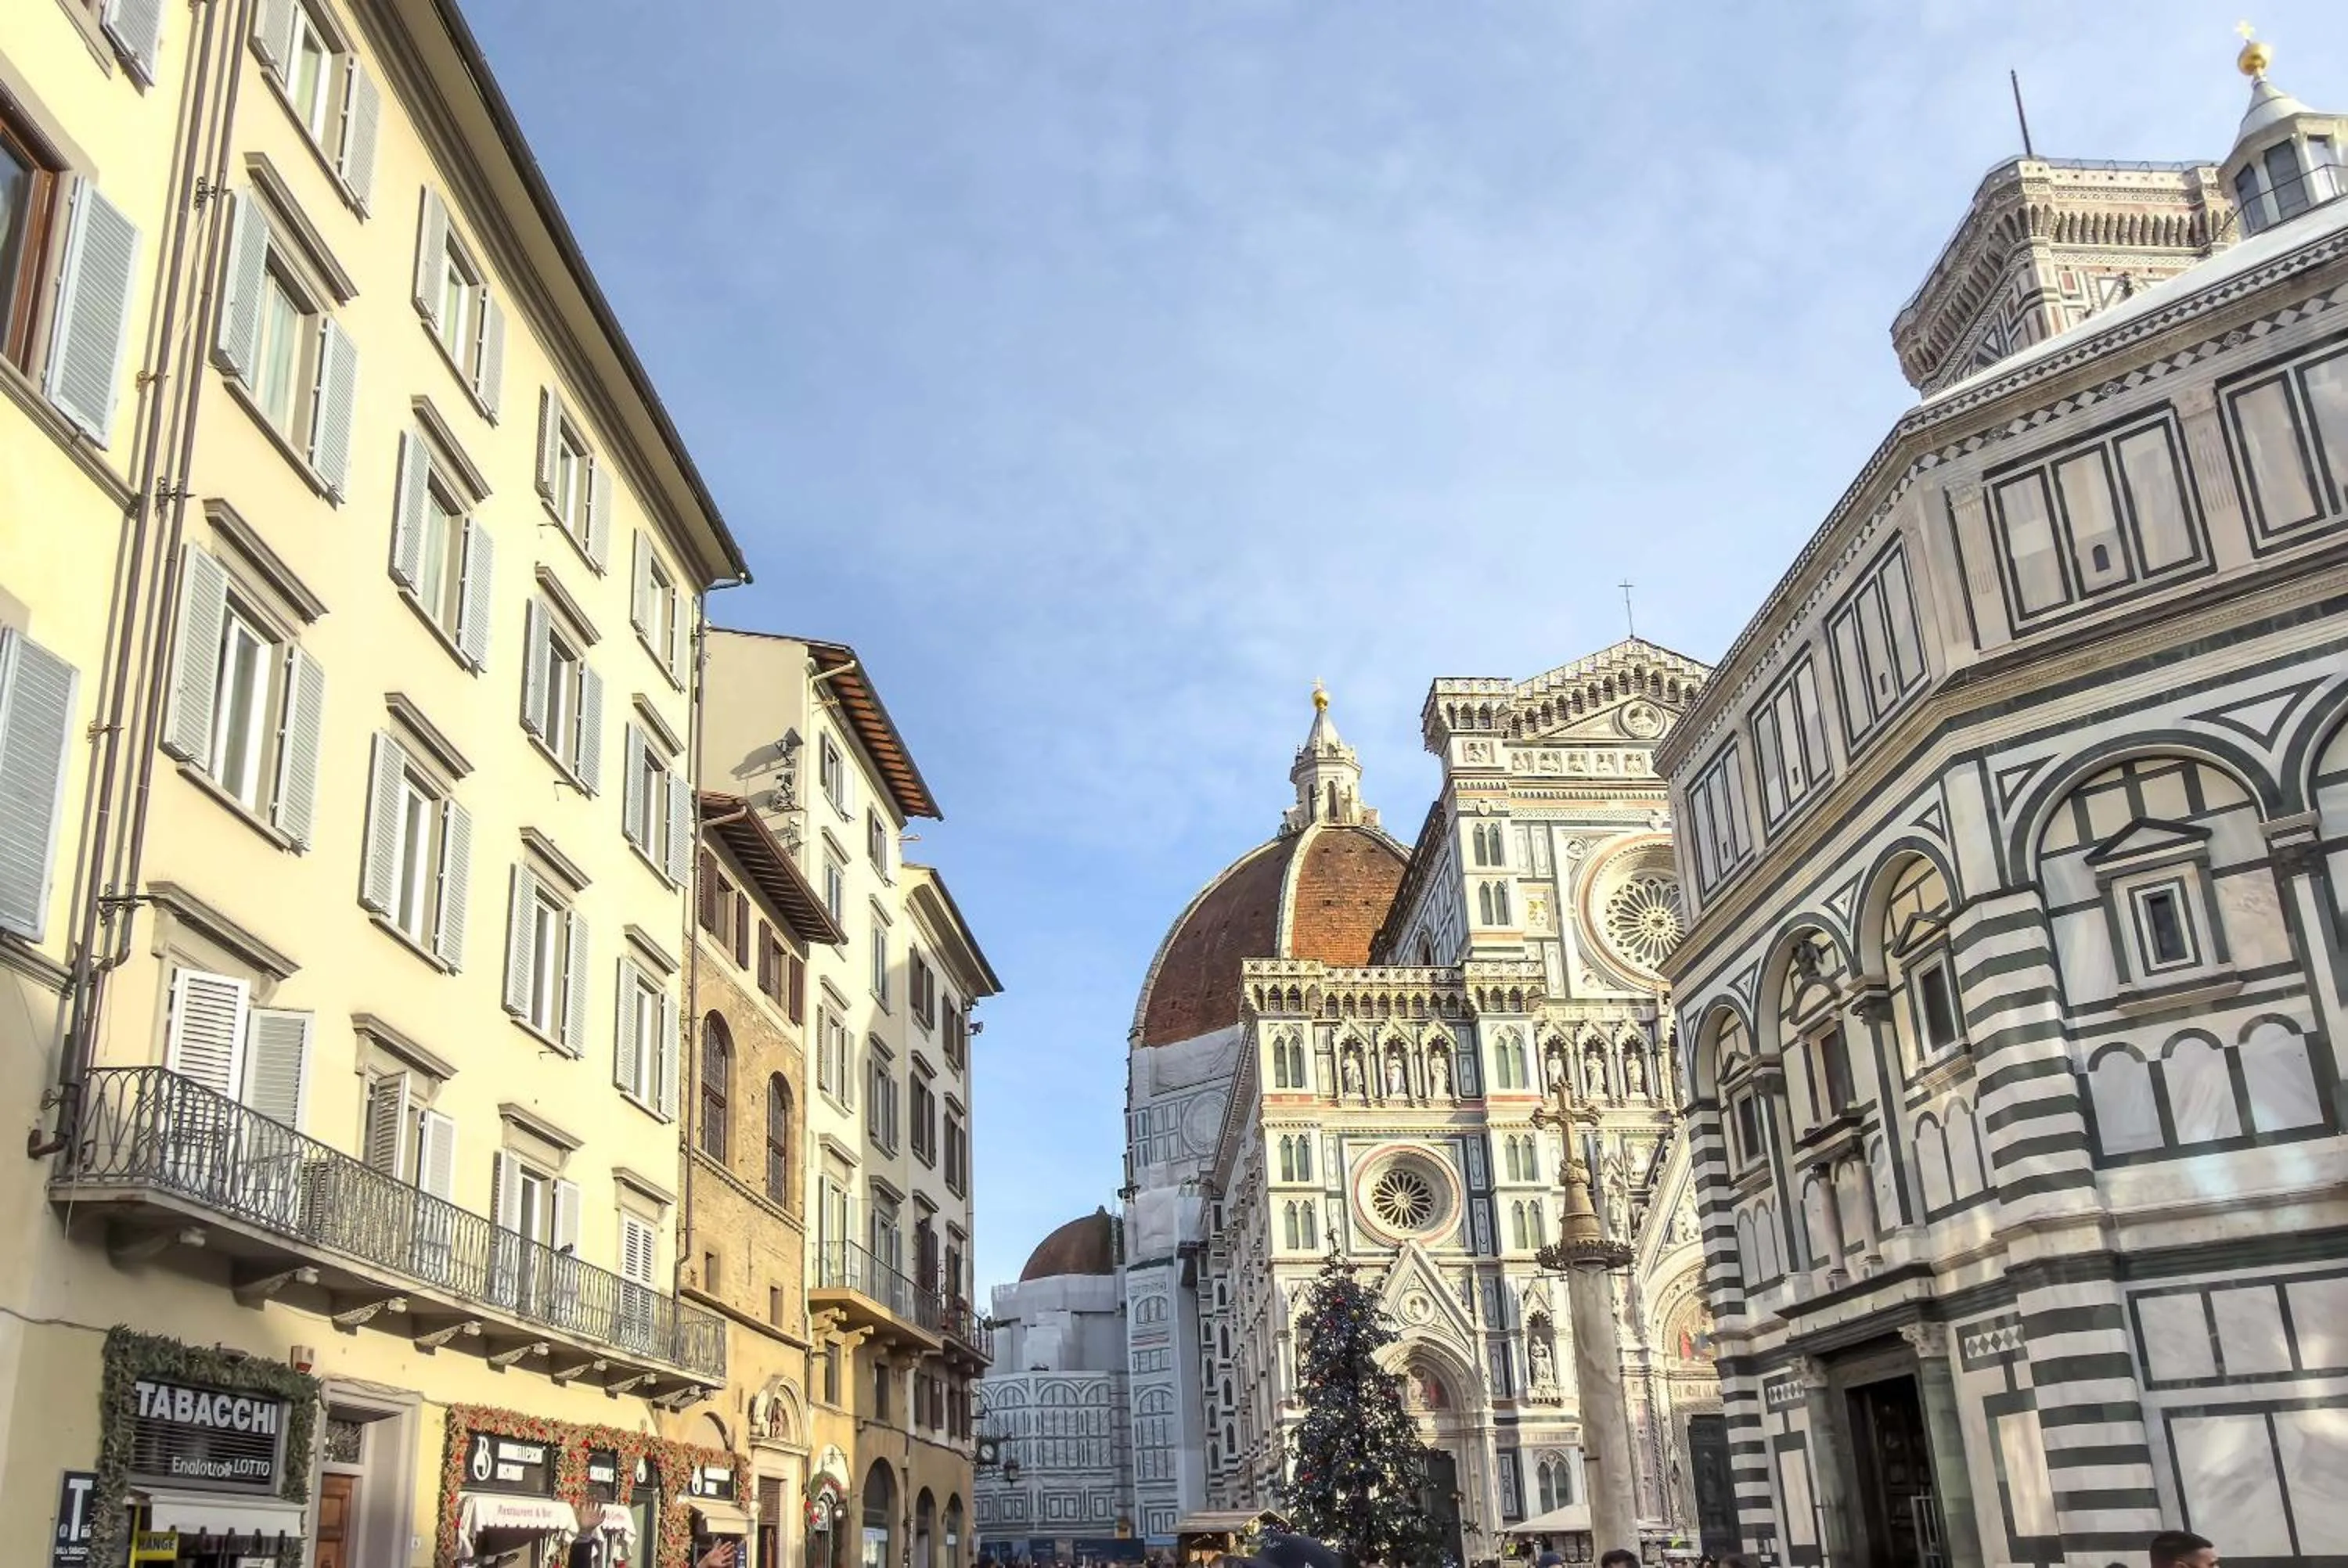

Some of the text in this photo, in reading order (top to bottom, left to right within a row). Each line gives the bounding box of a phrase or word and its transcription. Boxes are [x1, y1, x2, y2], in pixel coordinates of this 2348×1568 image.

[135, 1381, 278, 1434] TABACCHI
[234, 1458, 271, 1476] LOTTO
[68, 1478, 93, 1542] T
